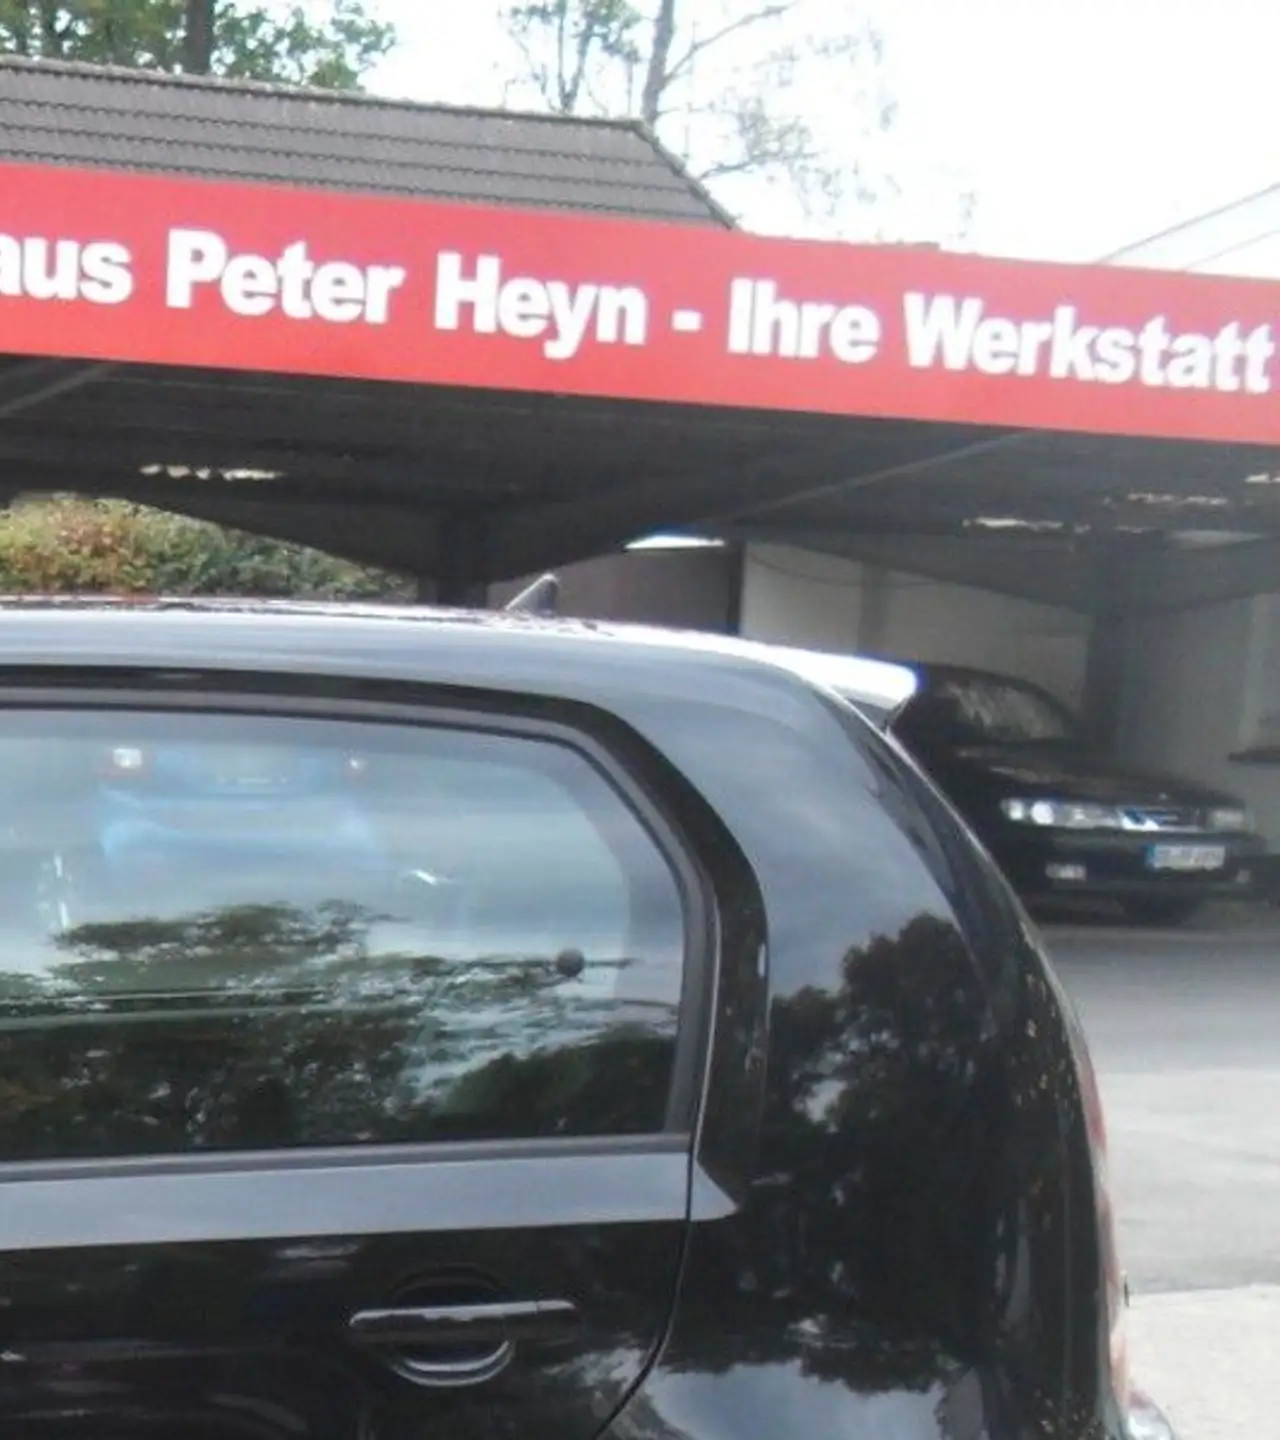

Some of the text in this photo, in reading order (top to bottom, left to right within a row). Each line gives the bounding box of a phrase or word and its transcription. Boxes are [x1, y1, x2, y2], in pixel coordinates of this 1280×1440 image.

[166, 229, 404, 323] Peter
[434, 252, 647, 357] Heyn
[728, 279, 879, 361] Ihre
[903, 292, 1274, 392] Werkstatt
